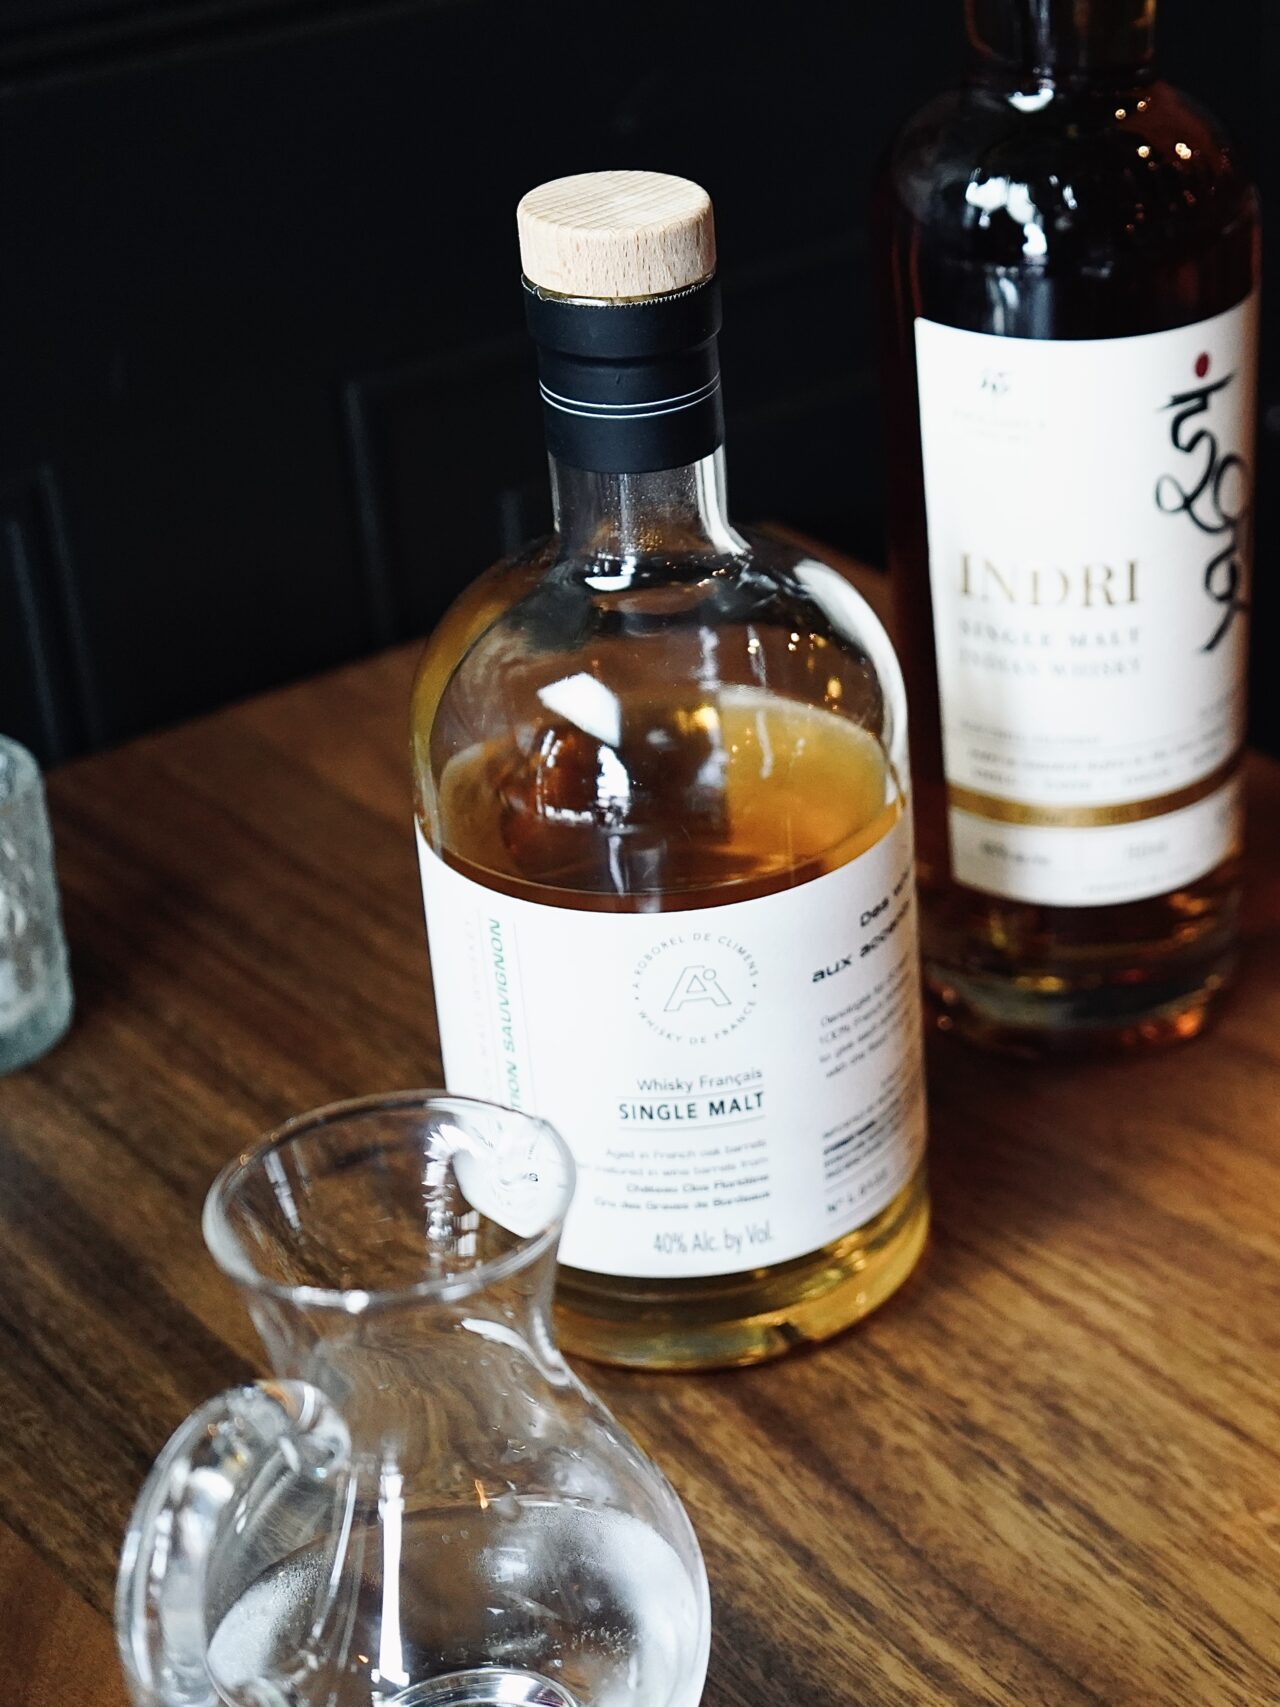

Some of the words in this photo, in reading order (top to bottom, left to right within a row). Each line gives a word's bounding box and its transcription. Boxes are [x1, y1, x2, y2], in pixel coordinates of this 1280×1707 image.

[959, 552, 1140, 607] INDRI
[692, 932, 712, 943] DE
[811, 952, 852, 983] aux
[488, 918, 516, 1054] SAUVIGNON
[506, 1060, 521, 1110] TION
[636, 1077, 694, 1094] Whisky
[699, 1067, 763, 1089] Français
[618, 1102, 699, 1121] SINGLE
[708, 1091, 765, 1117] MALT
[653, 1230, 689, 1255] 40%
[722, 1226, 743, 1255] by
